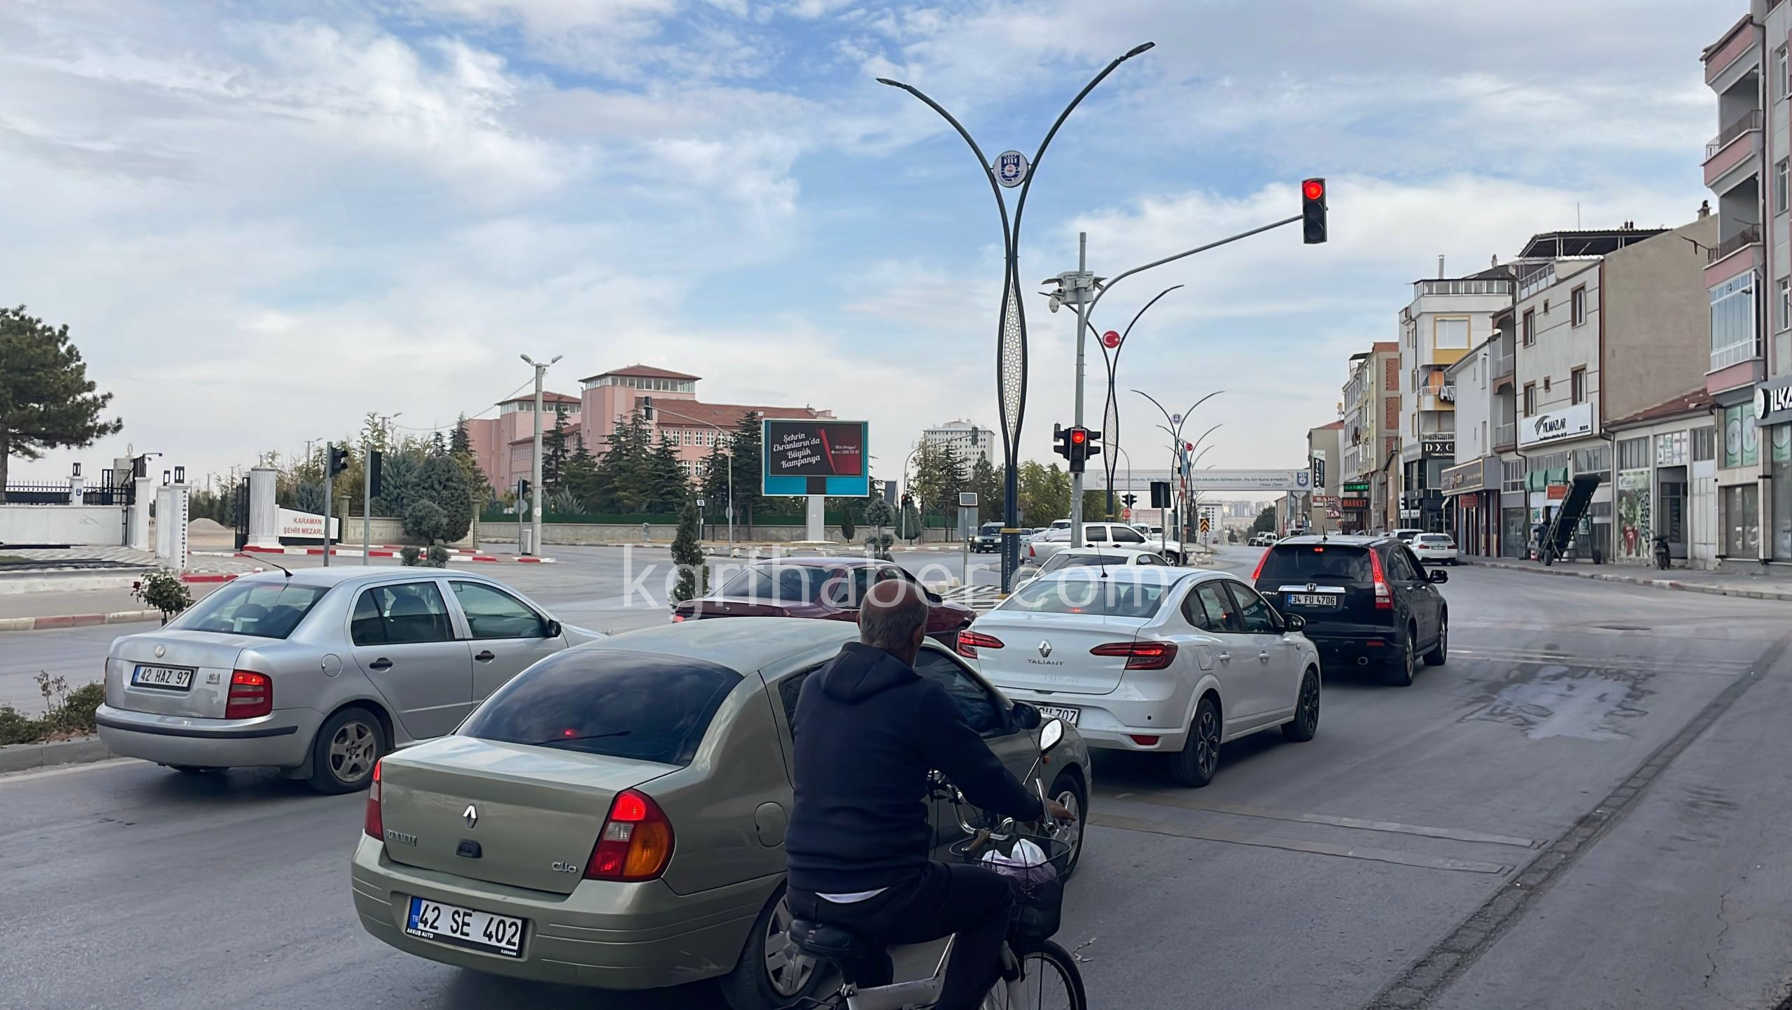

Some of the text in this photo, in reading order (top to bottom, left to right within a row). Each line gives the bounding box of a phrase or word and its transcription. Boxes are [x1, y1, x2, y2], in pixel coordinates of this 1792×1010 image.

[781, 455, 820, 469] Kampanya
[294, 516, 323, 525] KARAMAN
[1027, 658, 1064, 666] TALIANT
[140, 668, 152, 682] 42
[154, 670, 173, 684] HAZ
[176, 671, 190, 685] 97
[419, 904, 520, 947] 42 SE 402
